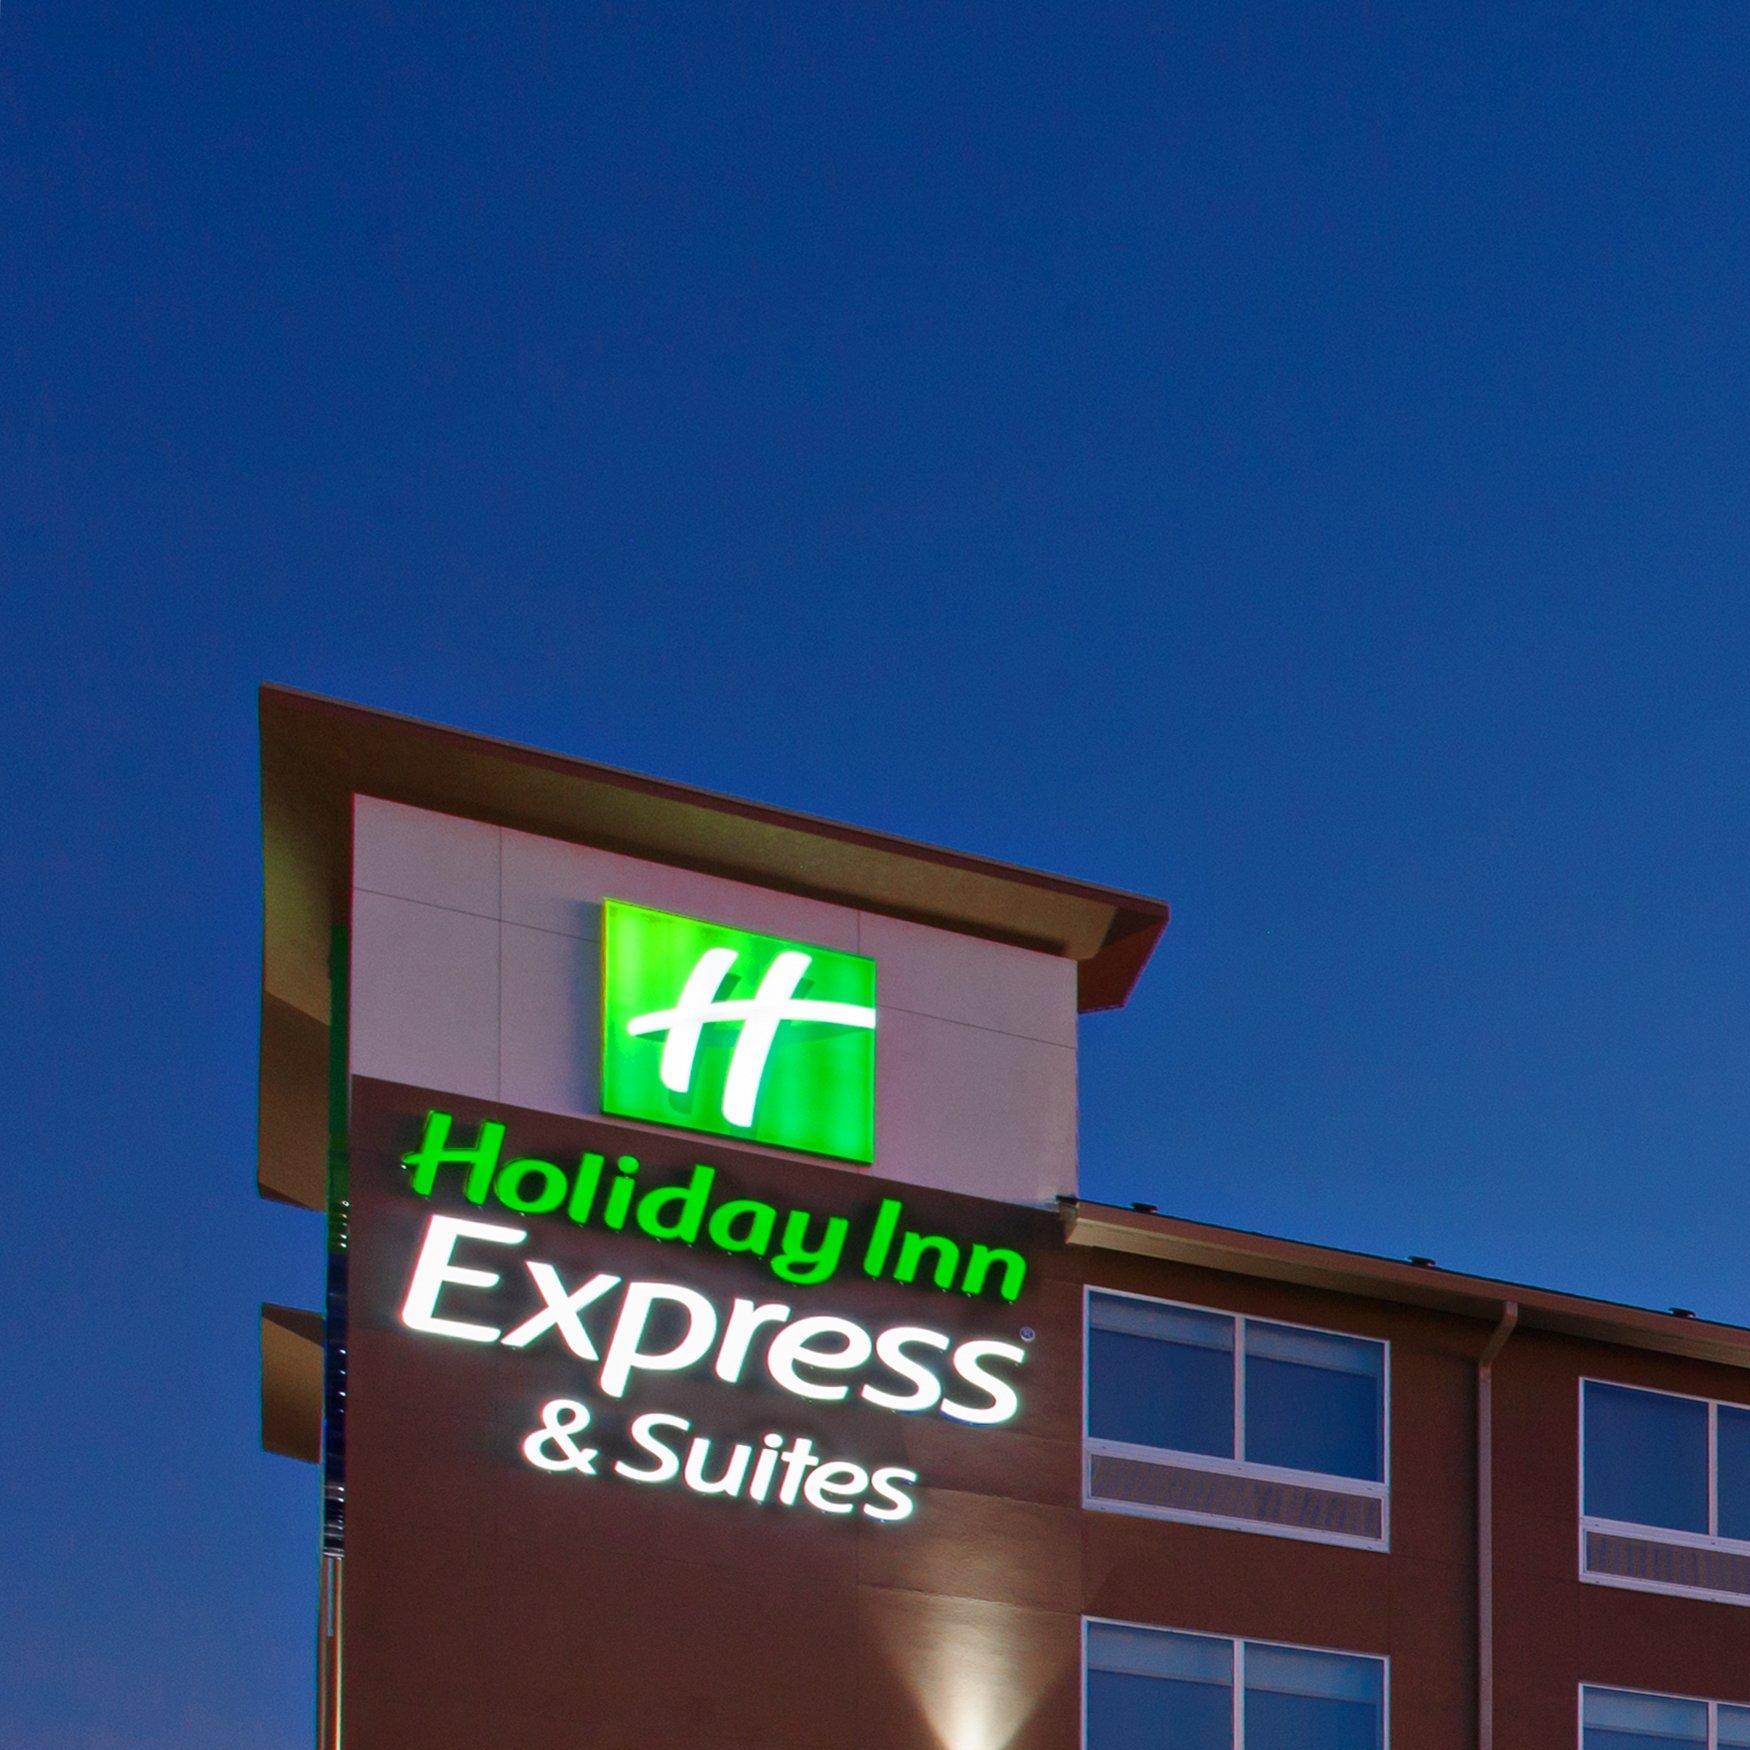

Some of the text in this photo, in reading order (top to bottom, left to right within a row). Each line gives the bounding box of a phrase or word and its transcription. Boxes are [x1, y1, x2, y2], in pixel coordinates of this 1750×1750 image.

[401, 1109, 1027, 1302] Holiday Inn
[400, 1213, 1026, 1425] Express
[522, 1397, 918, 1523] & Suites
